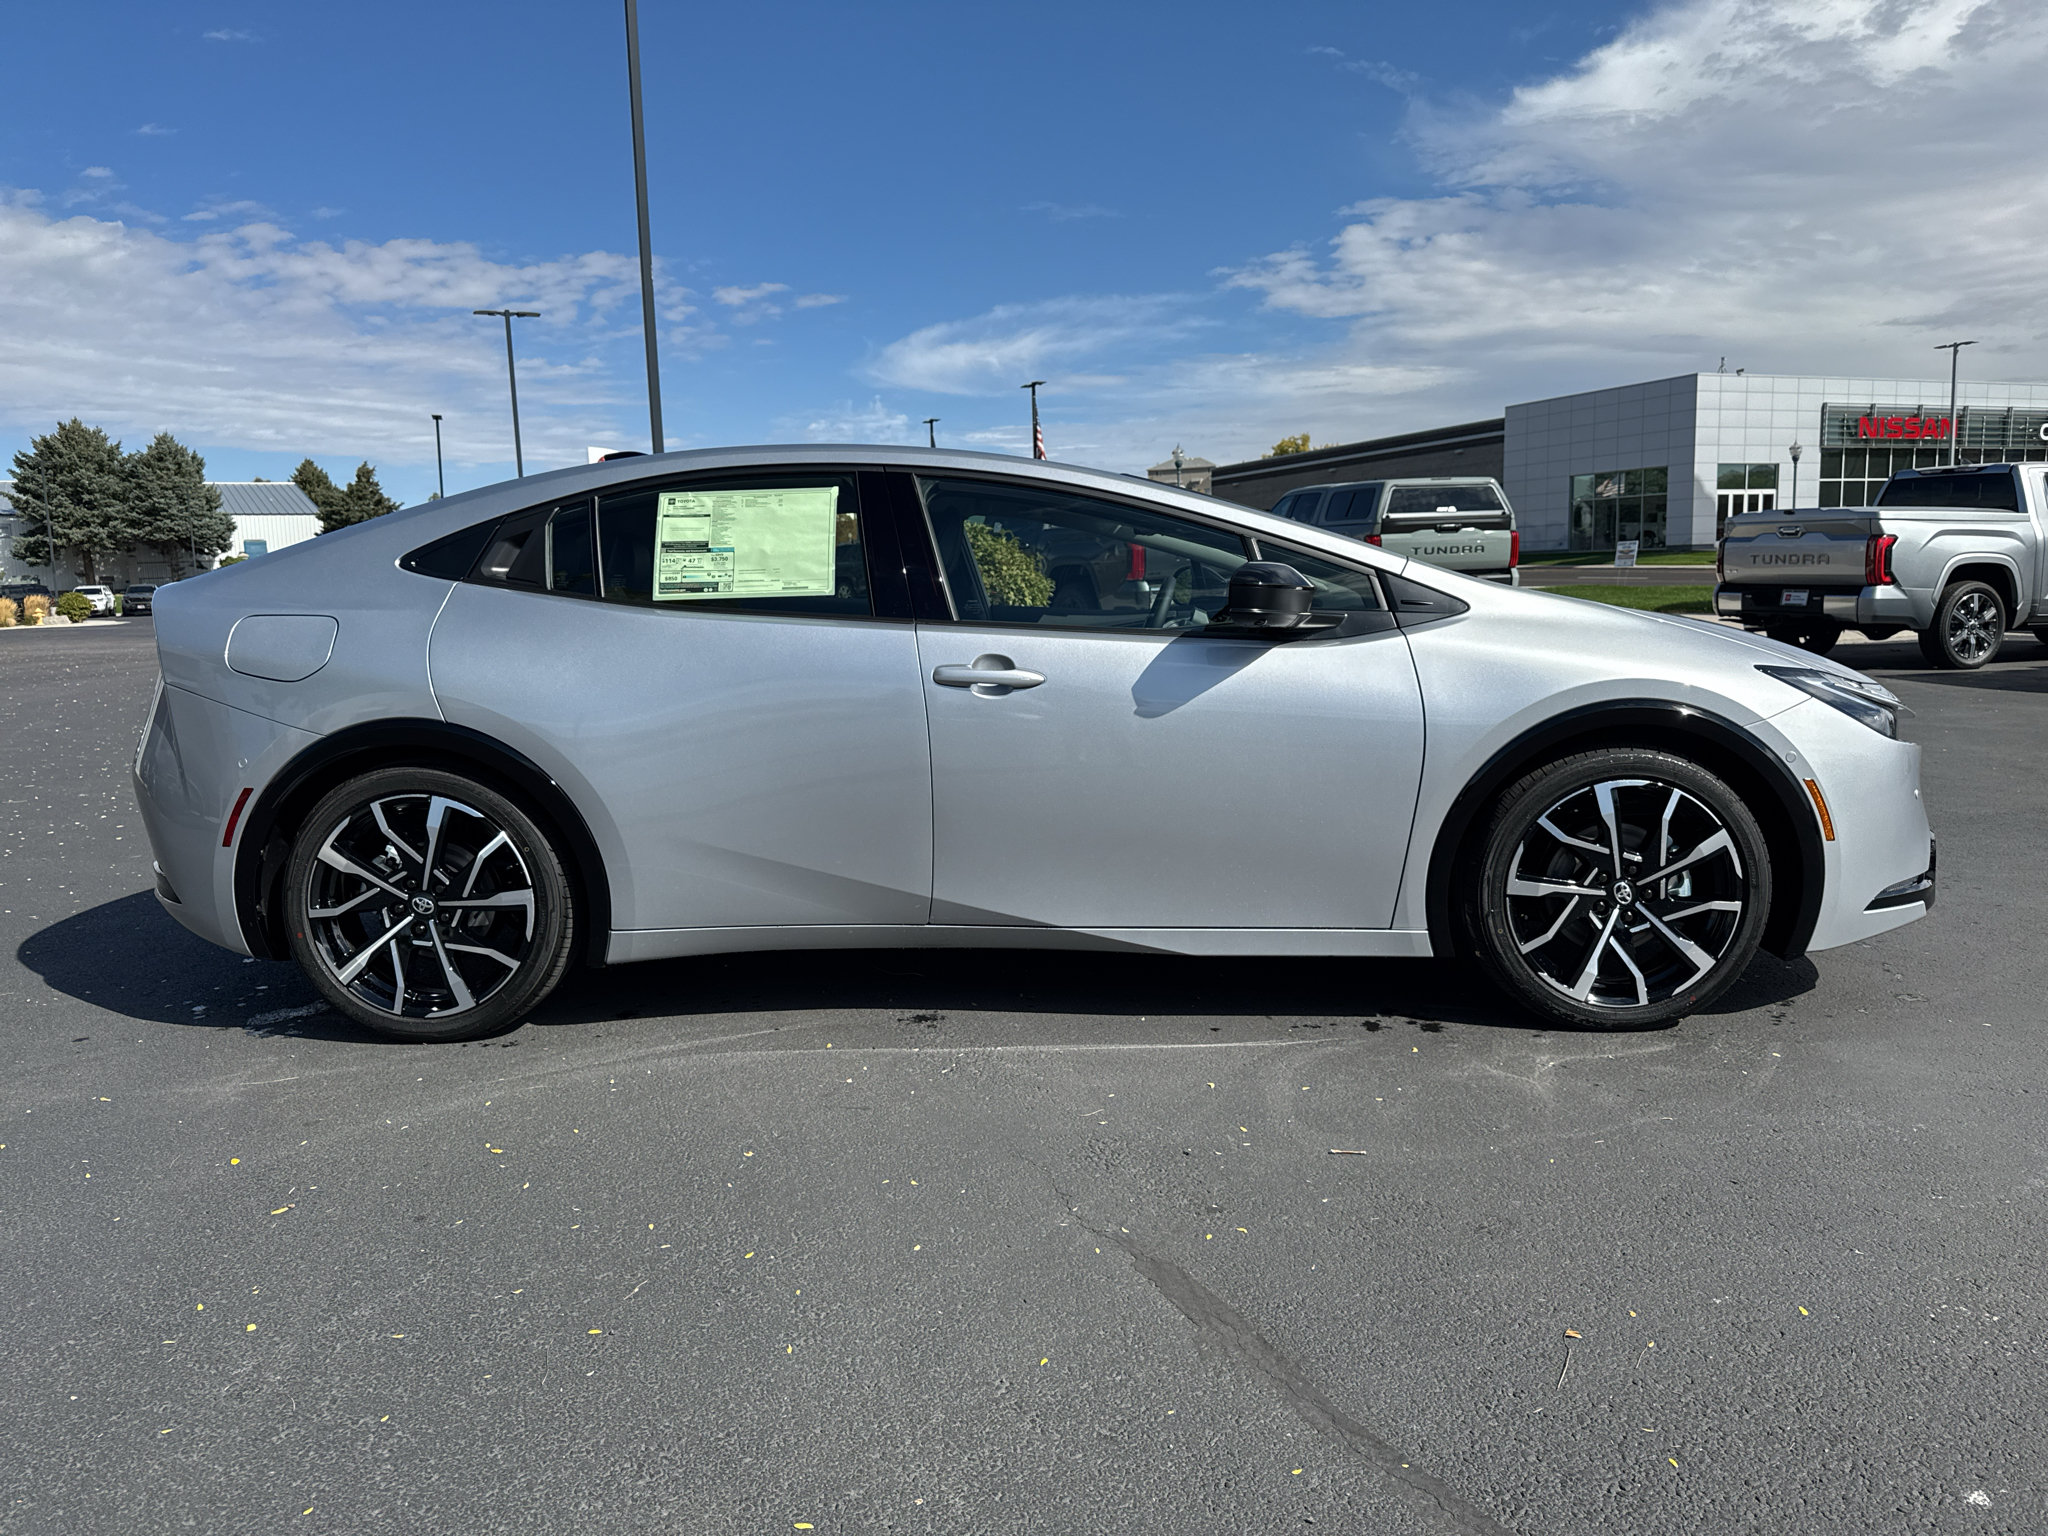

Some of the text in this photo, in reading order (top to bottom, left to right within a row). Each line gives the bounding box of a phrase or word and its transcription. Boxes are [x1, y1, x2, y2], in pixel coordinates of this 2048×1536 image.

[1858, 416, 1958, 439] NISSAN
[1411, 545, 1485, 555] TUNDRA
[1750, 554, 1830, 565] TUNDRA
